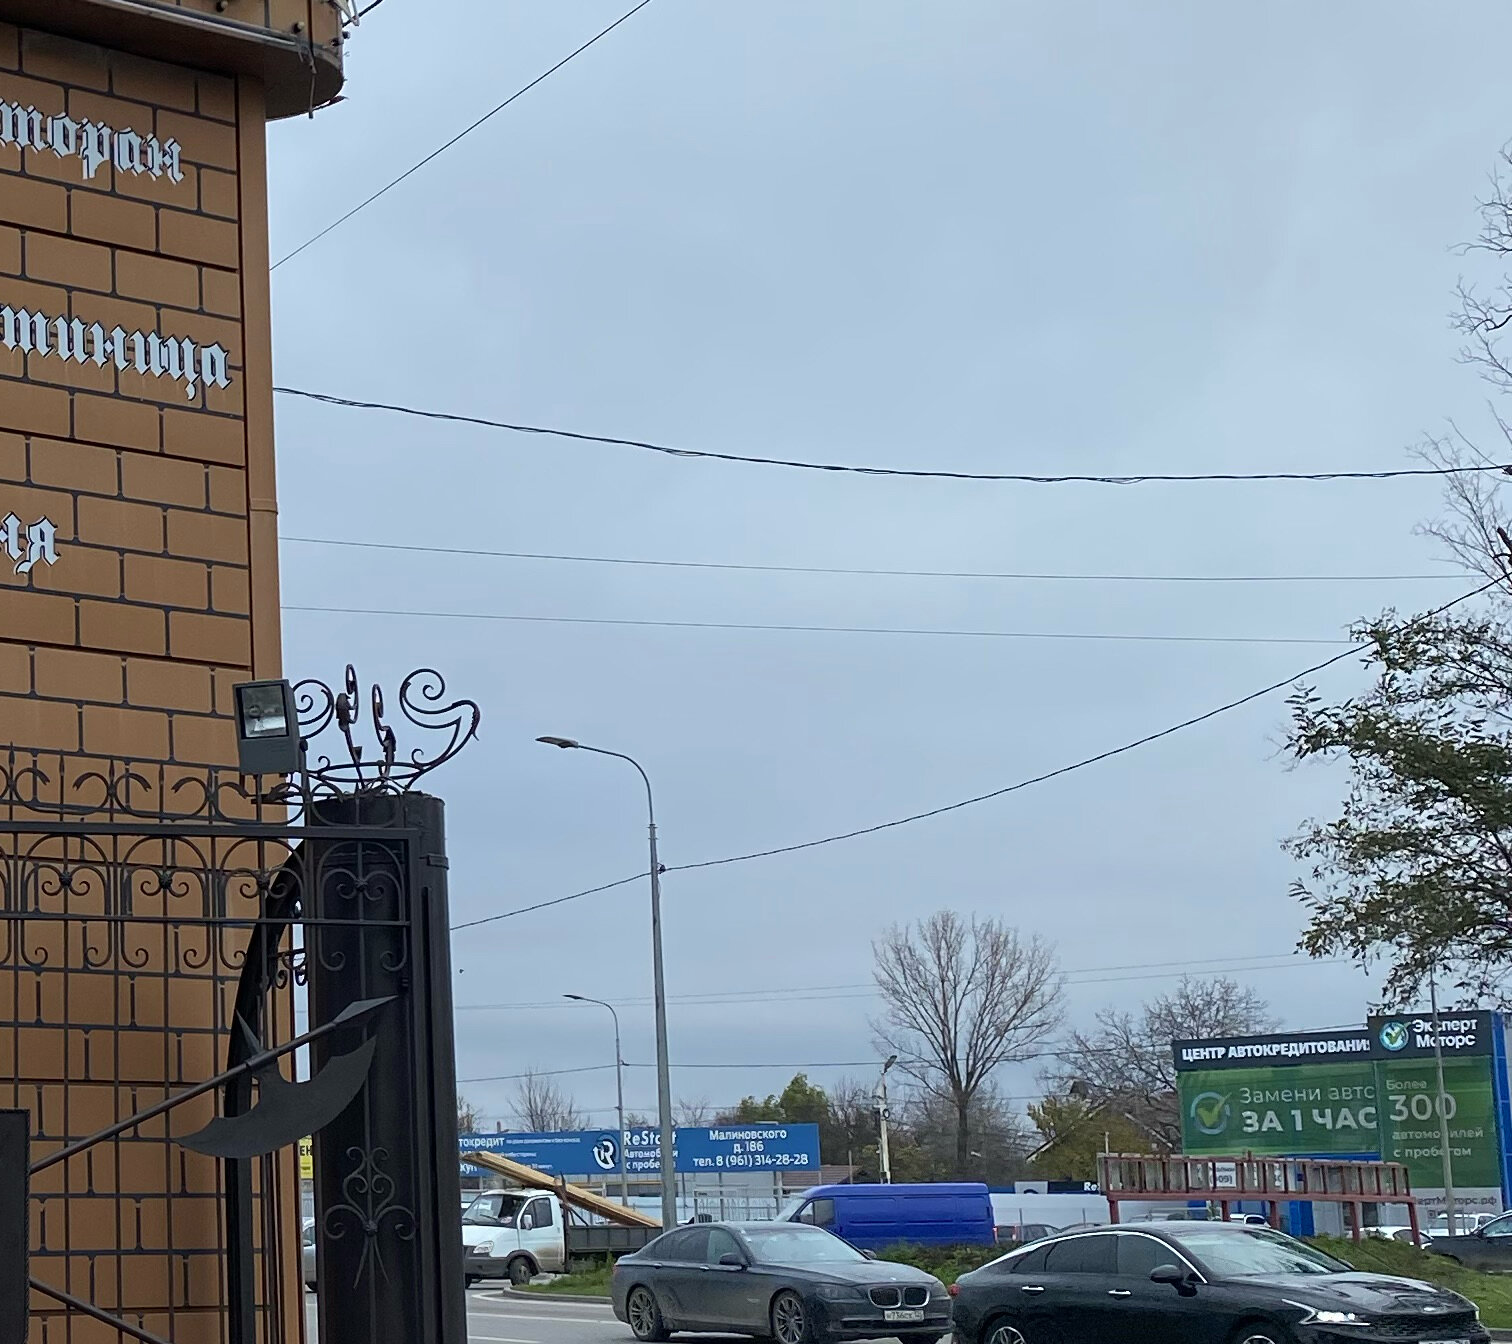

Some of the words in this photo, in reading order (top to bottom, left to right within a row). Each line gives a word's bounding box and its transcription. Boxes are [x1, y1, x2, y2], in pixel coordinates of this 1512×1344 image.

[1181, 1047, 1226, 1062] ЦЕНТР
[1228, 1039, 1371, 1058] АВТОКРЕДИТОВАНИ
[1386, 1079, 1428, 1090] Более
[1240, 1087, 1321, 1104] Замени
[1388, 1094, 1457, 1121] 300
[1241, 1110, 1284, 1133] ЗА
[1291, 1109, 1303, 1131] 1
[1312, 1106, 1378, 1130] ЧАС
[709, 1129, 788, 1141] Малиновского
[1392, 1127, 1484, 1140] автомоилей
[624, 1147, 678, 1158] Автомоби
[1393, 1149, 1402, 1157] с
[693, 1157, 714, 1167] тел.
[715, 1155, 724, 1166] 8
[725, 1154, 753, 1167] (961)
[754, 1153, 809, 1165] 314-28-28
